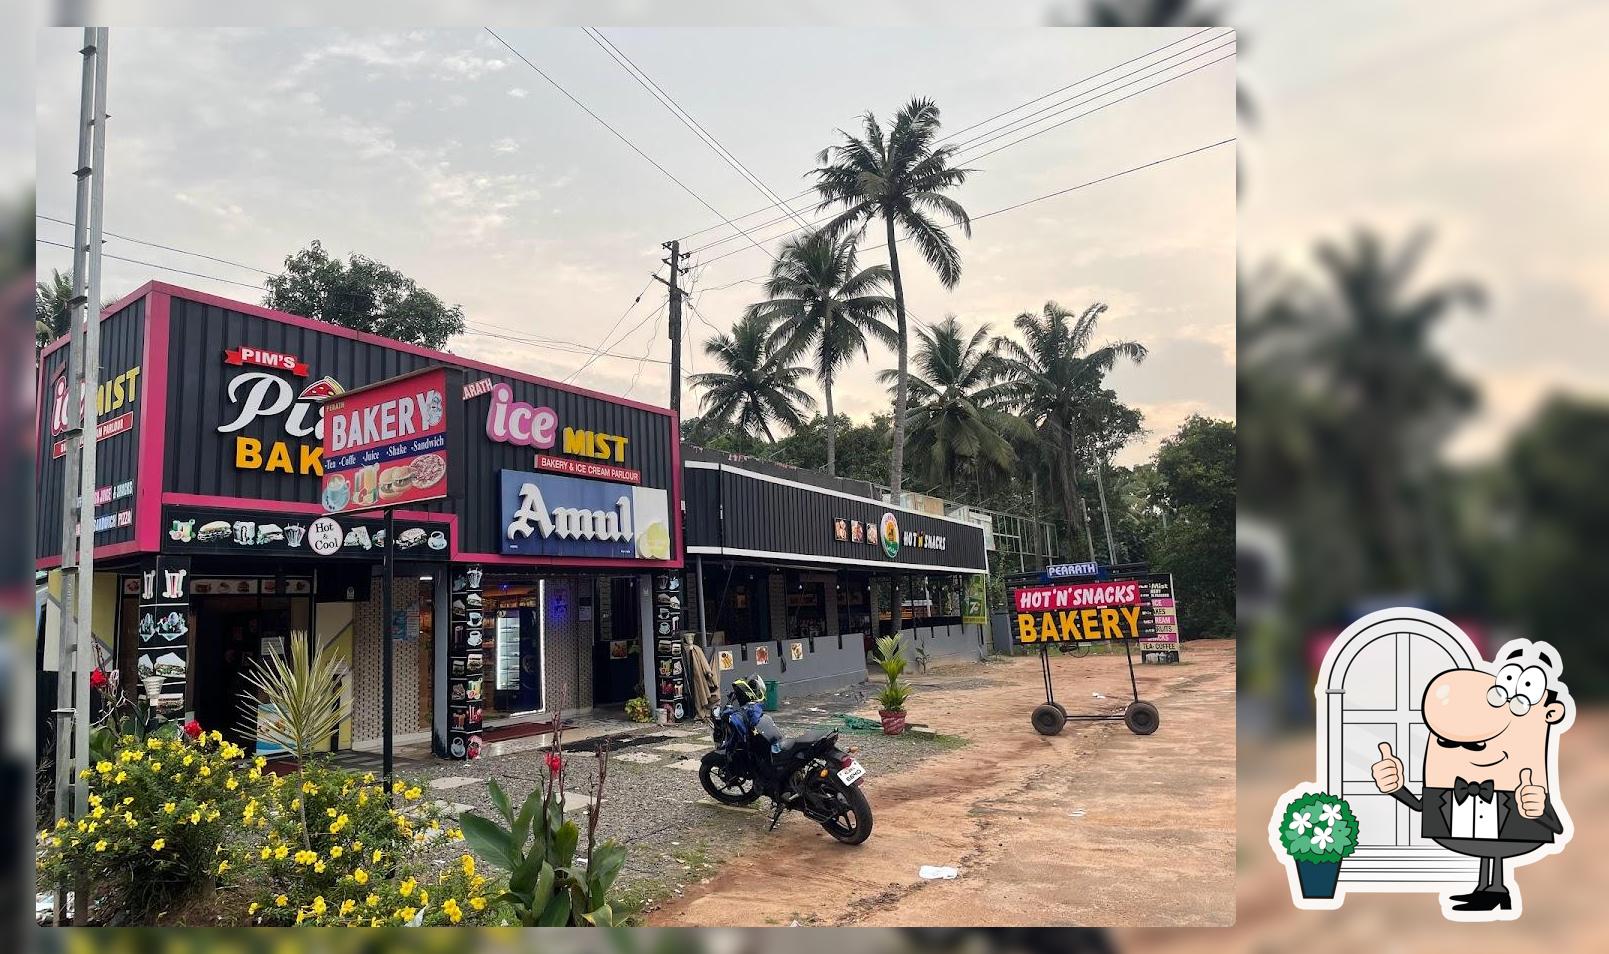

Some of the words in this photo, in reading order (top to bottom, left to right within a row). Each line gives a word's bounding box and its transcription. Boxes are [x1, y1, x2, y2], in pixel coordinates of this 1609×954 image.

[241, 348, 296, 369] PIM'S
[462, 377, 494, 400] ARATH
[332, 390, 437, 451] BAKERY
[493, 387, 555, 444] ice
[413, 435, 444, 452] Sandwich
[562, 426, 629, 463] MIST
[541, 457, 568, 471] BAKERY
[569, 462, 575, 471] &
[575, 463, 587, 474] ICE
[587, 465, 611, 477] CREAM
[611, 469, 639, 481] PARLOUR
[507, 483, 634, 543] Amul
[316, 522, 334, 533] Hot
[315, 538, 338, 551] Cool
[1048, 563, 1096, 576] PEARATH
[1017, 606, 1140, 643] BAKERY
